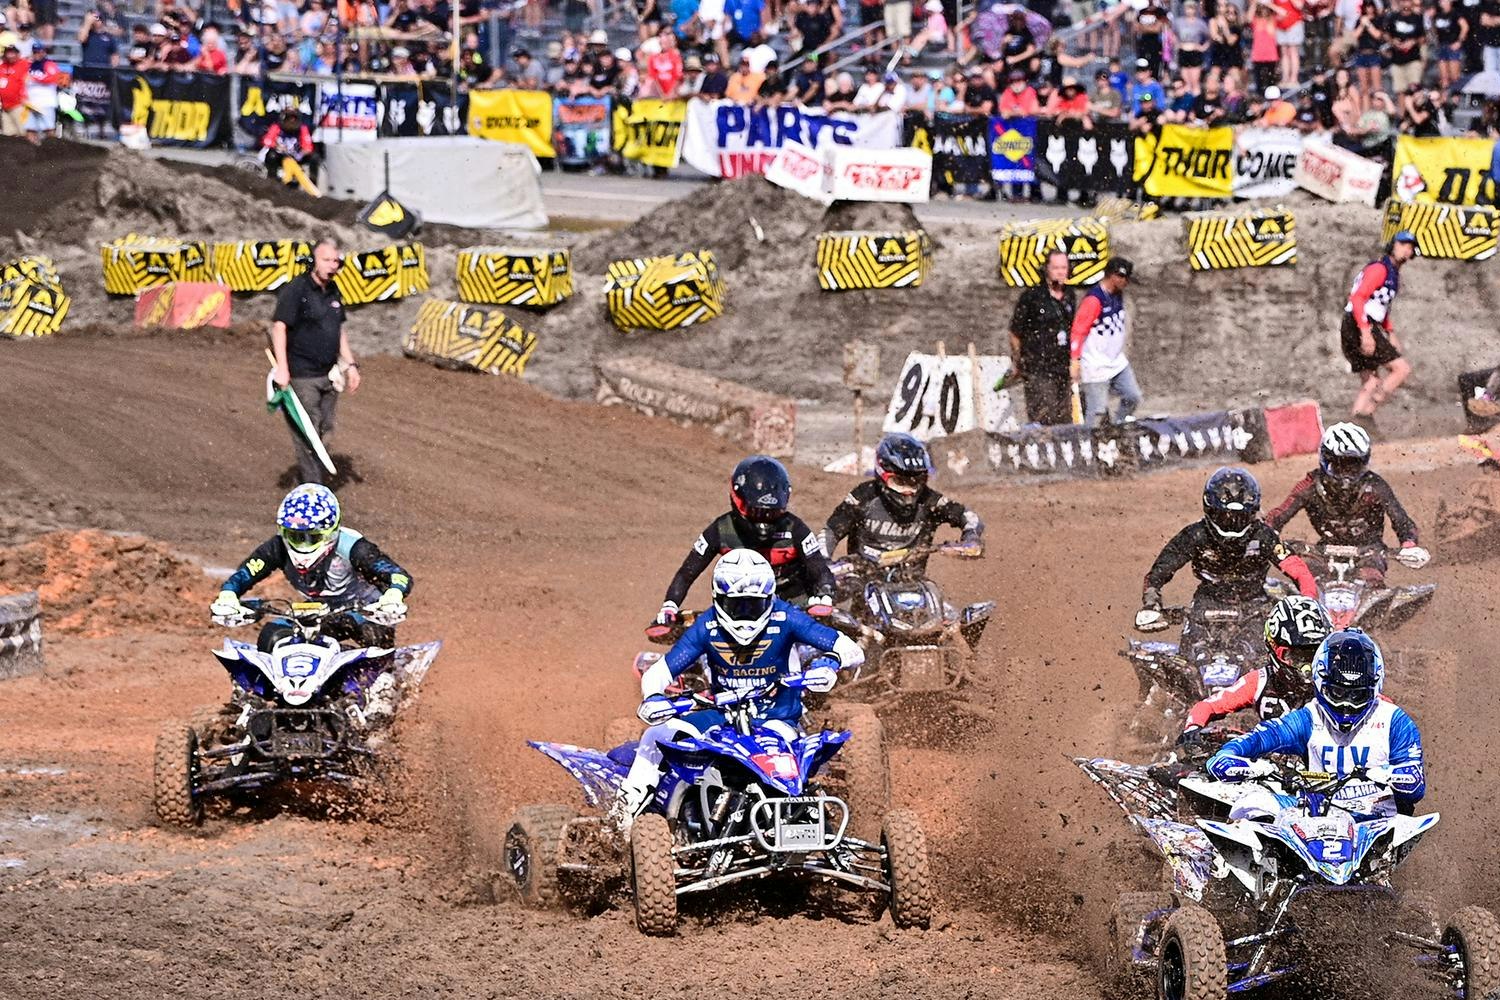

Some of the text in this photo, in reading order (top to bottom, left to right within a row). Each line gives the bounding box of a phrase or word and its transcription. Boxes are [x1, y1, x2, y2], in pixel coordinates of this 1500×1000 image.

[151, 99, 211, 142] THOR
[717, 104, 858, 150] PARTS
[1161, 146, 1231, 179] THOR
[733, 665, 777, 677] RACING
[1320, 744, 1370, 782] FLY
[1322, 840, 1343, 858] 2
